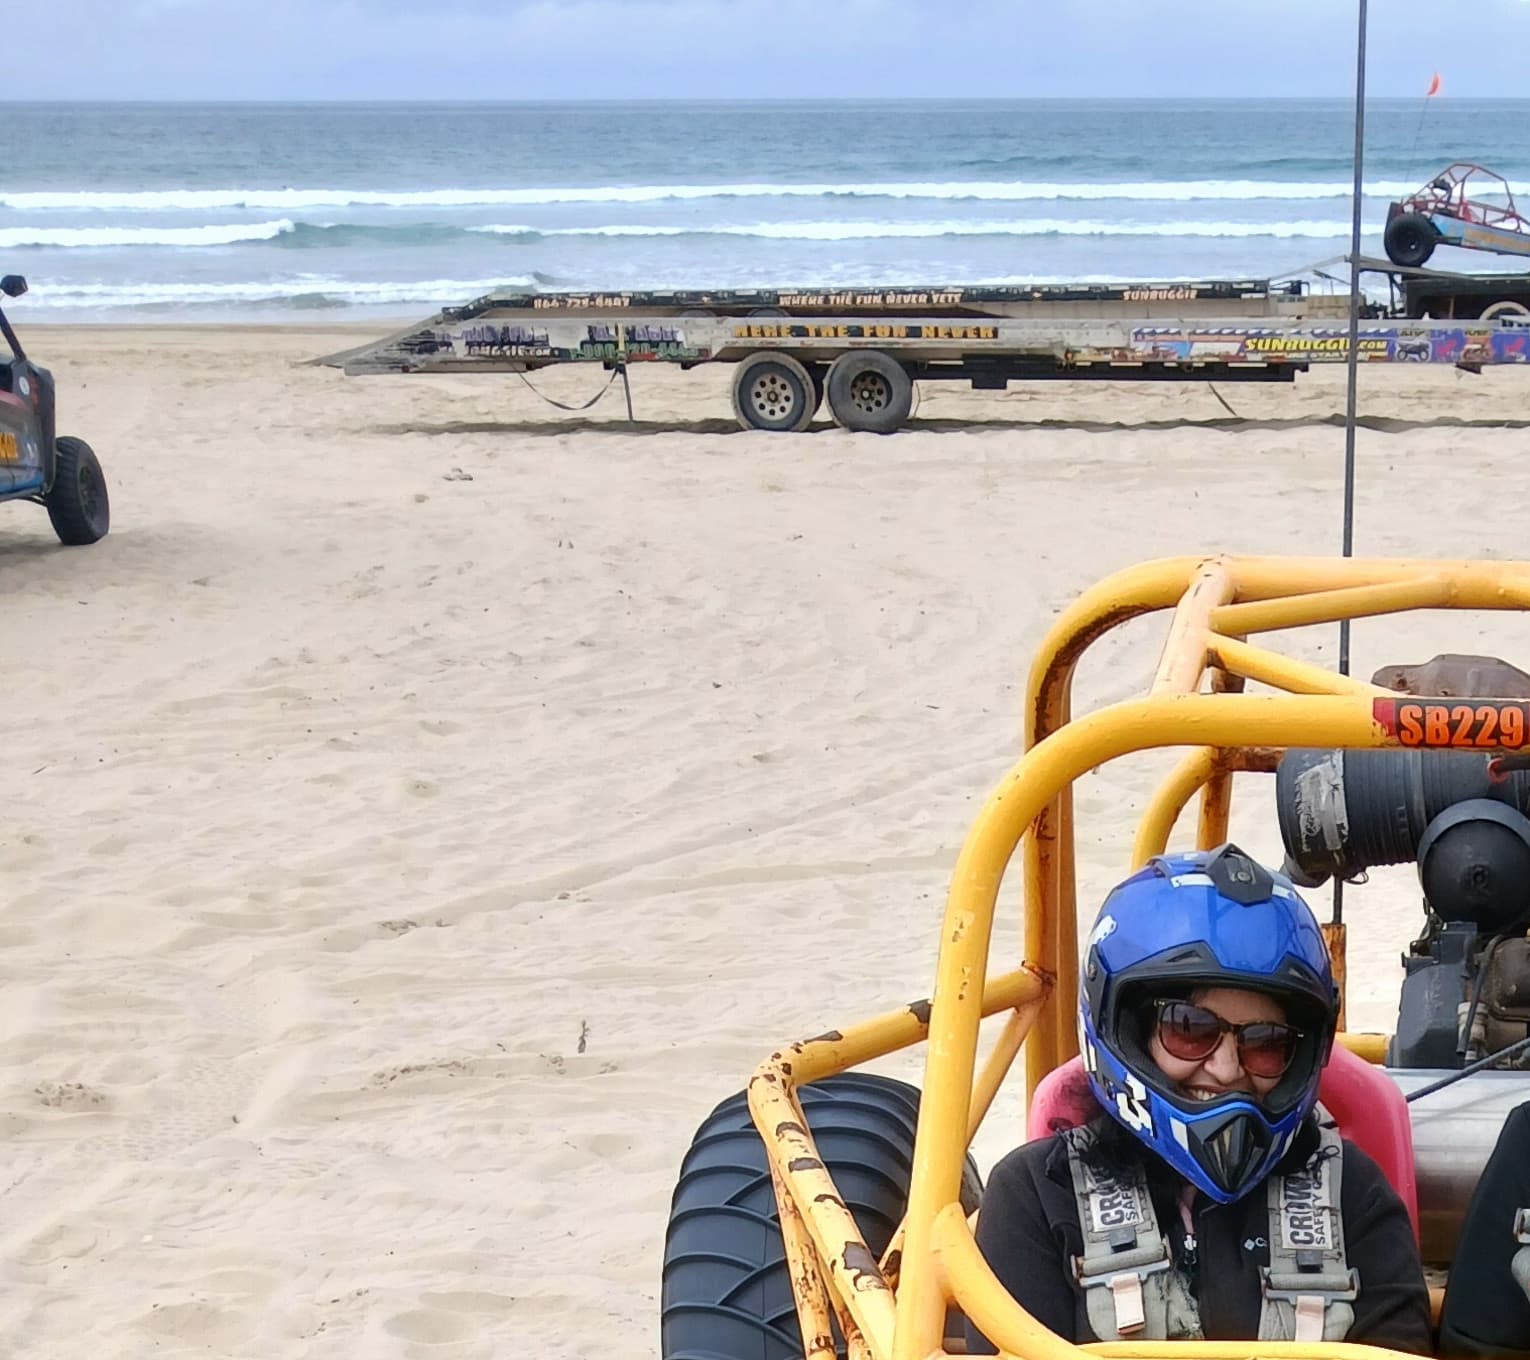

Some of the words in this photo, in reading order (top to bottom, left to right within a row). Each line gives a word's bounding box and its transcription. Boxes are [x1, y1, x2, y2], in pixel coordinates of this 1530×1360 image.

[829, 293, 854, 305] THE
[856, 293, 883, 305] FUN
[886, 293, 928, 305] NEVER
[1122, 289, 1198, 301] SUNBUGGIE
[806, 325, 849, 338] THE
[921, 325, 996, 338] NEVER
[1245, 337, 1388, 352] SUNBUGGICOM
[1399, 704, 1525, 748] SB229
[1119, 1183, 1138, 1222] SAFE
